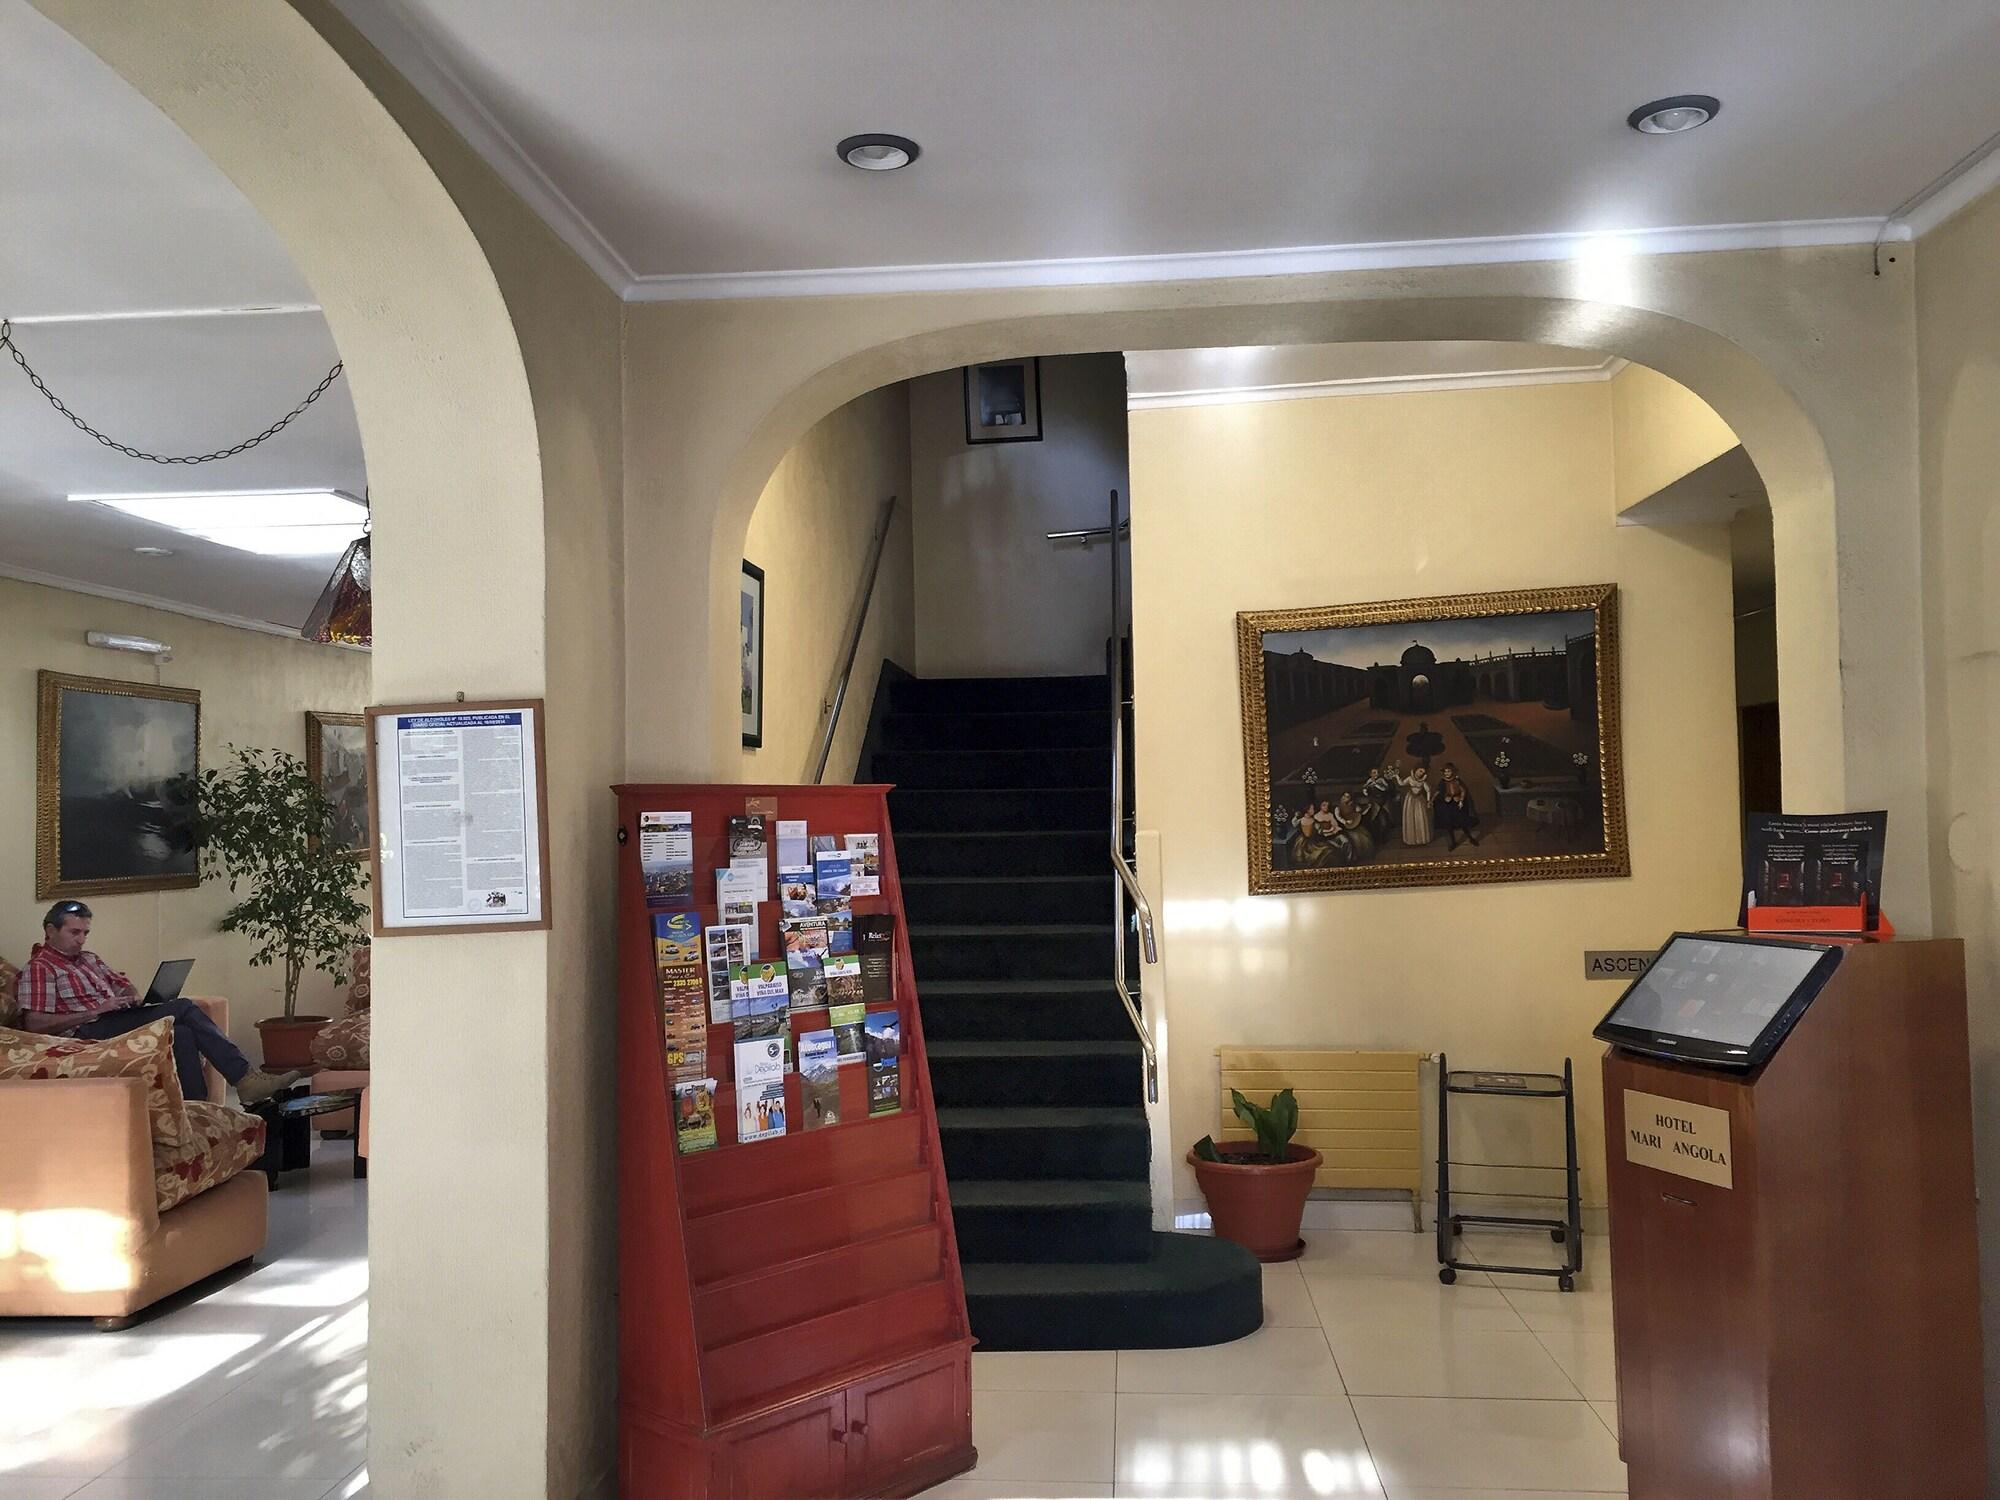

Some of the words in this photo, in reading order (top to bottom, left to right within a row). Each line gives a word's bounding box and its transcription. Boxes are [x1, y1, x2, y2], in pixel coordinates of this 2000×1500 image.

[667, 1052, 684, 1065] GPS
[755, 1062, 781, 1074] Depilab
[1656, 1114, 1697, 1135] HOTEL
[1631, 1129, 1662, 1149] MARI
[1673, 1141, 1727, 1166] ANGOLA
